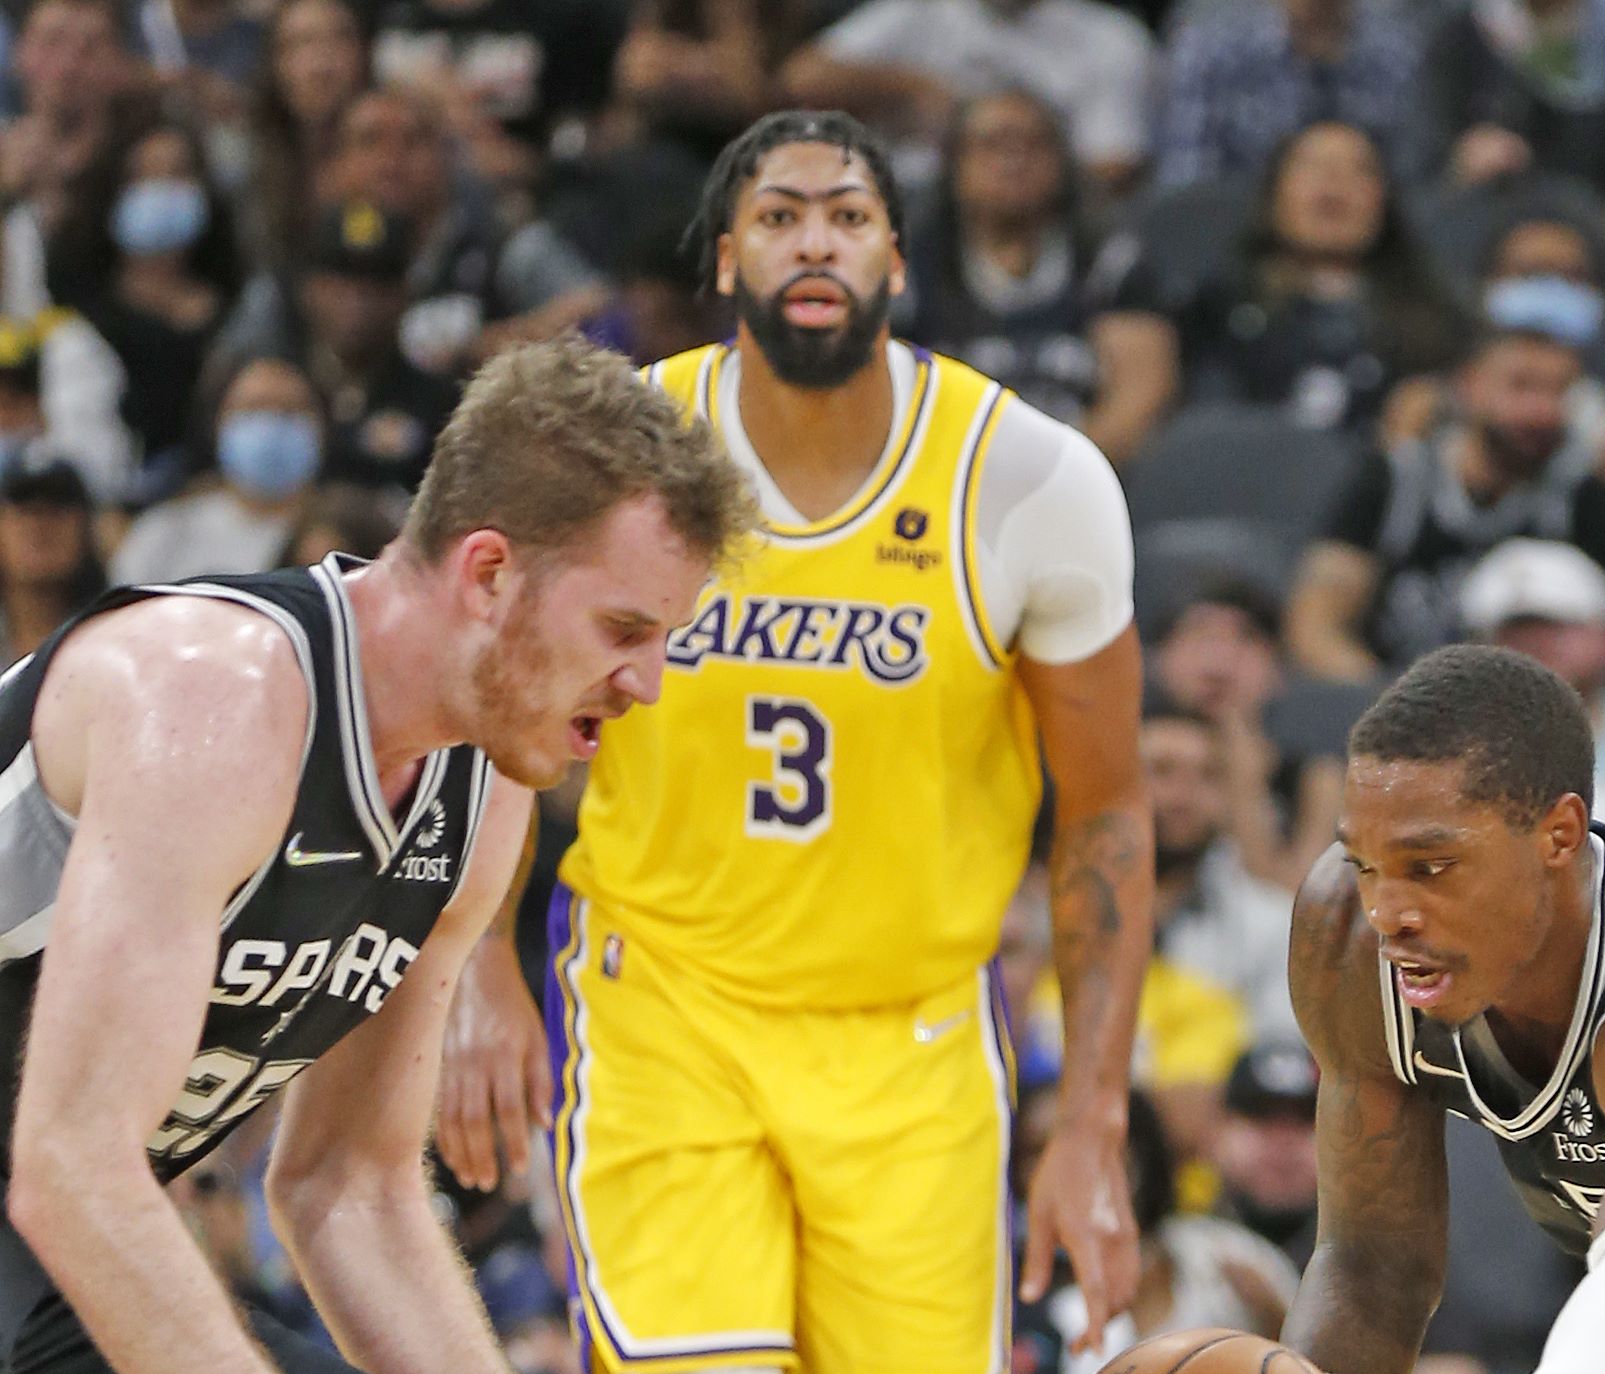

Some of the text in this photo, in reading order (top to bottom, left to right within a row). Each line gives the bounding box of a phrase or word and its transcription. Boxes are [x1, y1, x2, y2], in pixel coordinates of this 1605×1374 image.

[664, 596, 930, 684] AKERS
[747, 694, 832, 842] 3
[393, 849, 452, 882] rost
